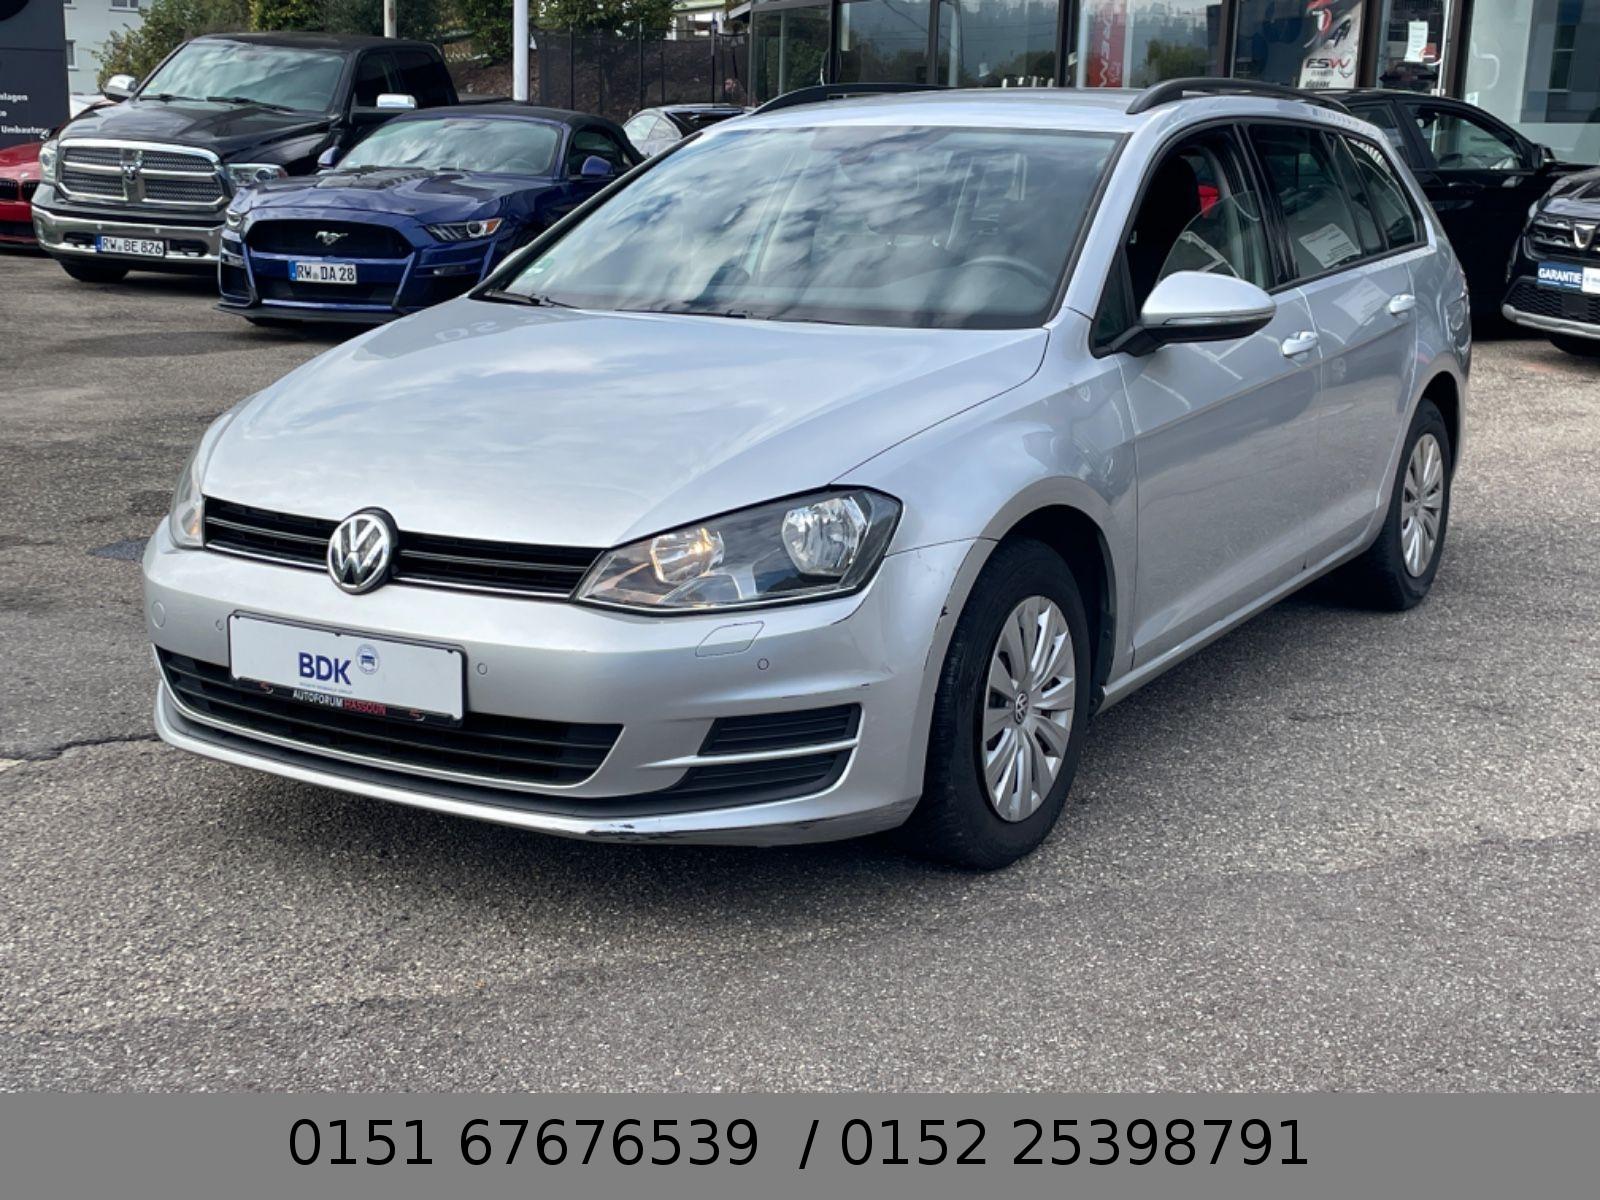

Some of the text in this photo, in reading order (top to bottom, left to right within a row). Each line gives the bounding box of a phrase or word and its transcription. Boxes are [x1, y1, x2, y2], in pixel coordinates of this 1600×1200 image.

[102, 238, 117, 250] RW
[297, 264, 355, 281] RW DA 28
[1539, 267, 1582, 283] GARANTIE
[298, 652, 352, 685] BDK
